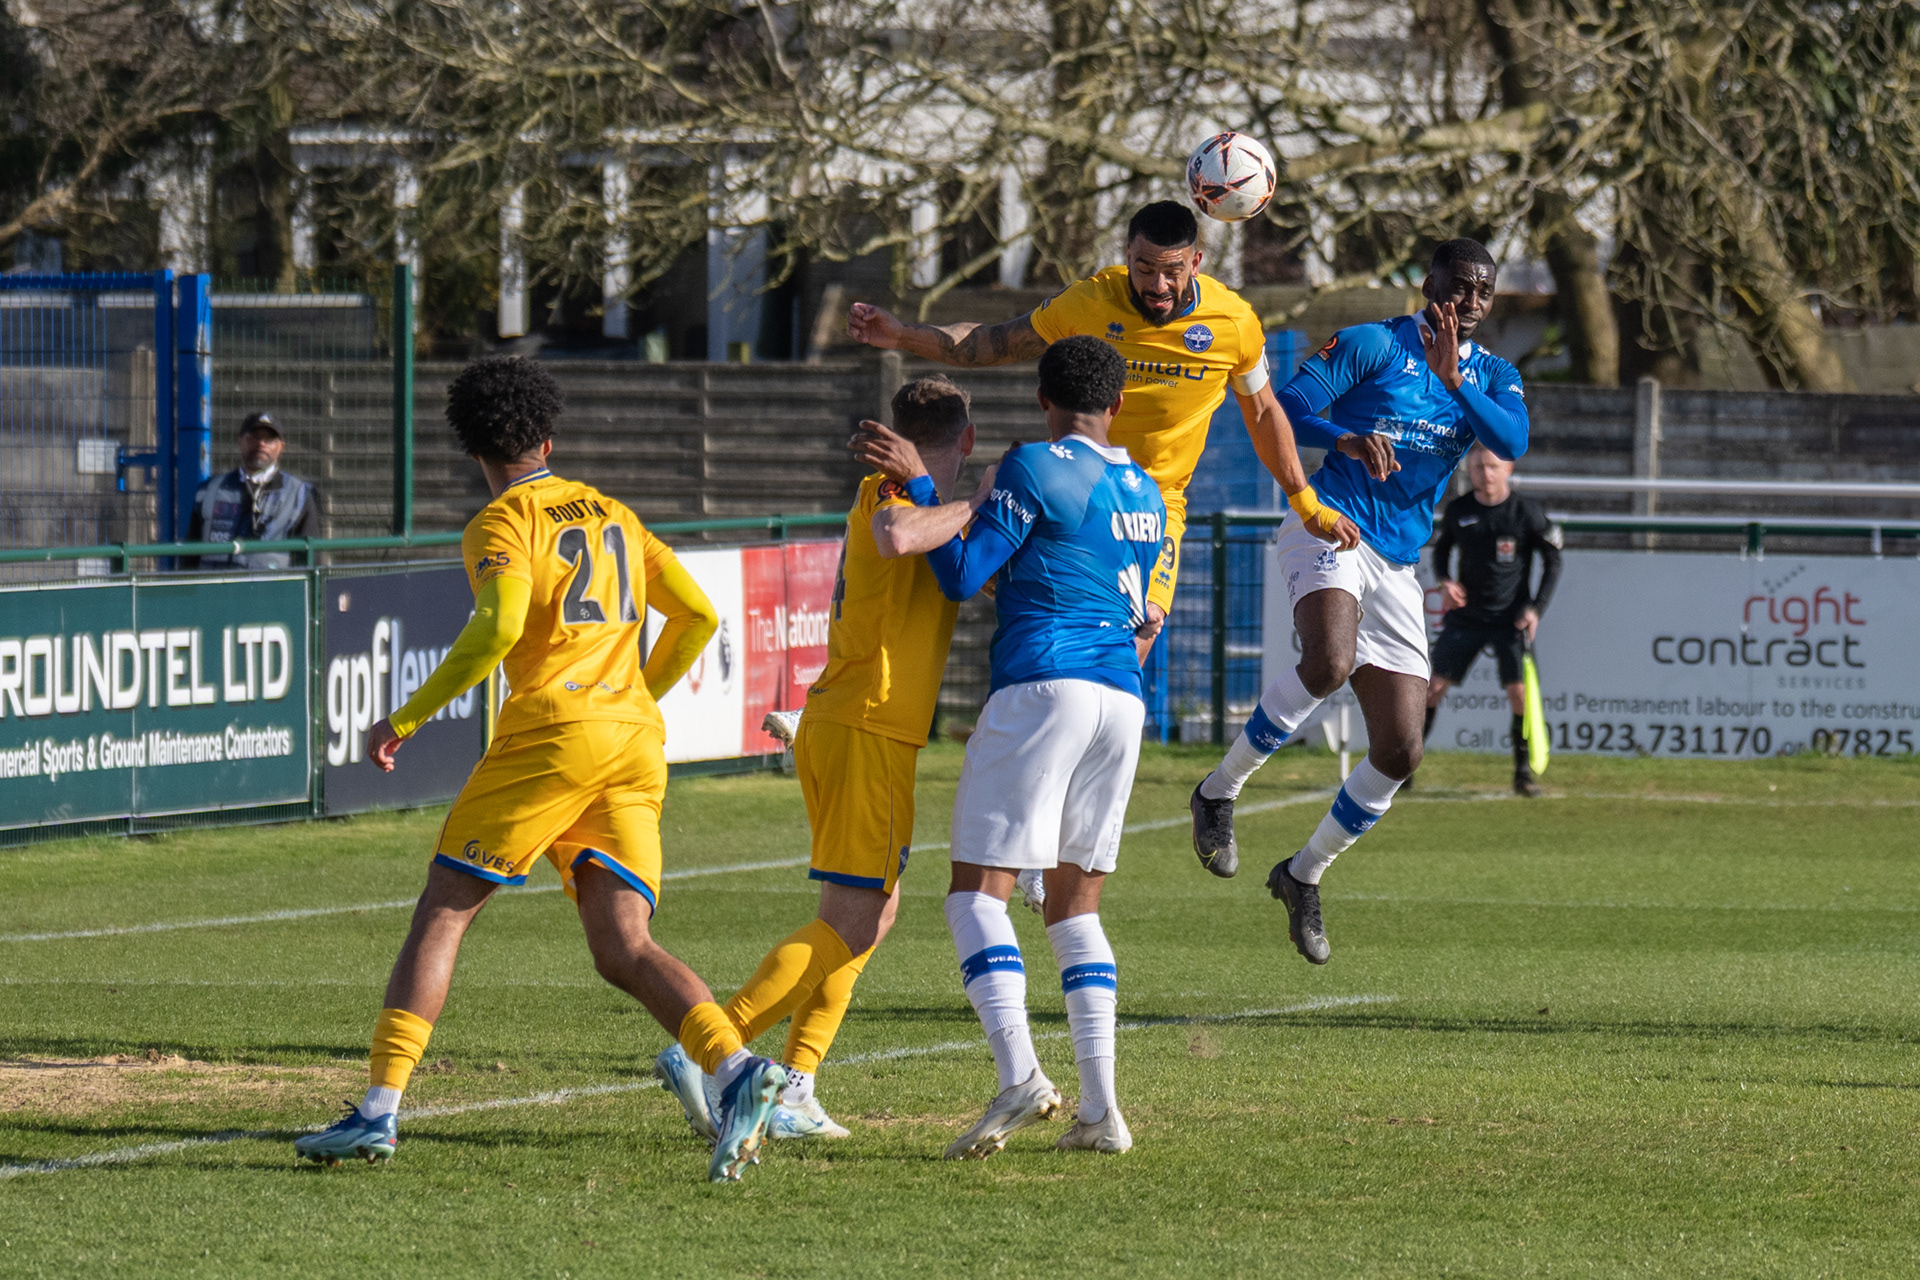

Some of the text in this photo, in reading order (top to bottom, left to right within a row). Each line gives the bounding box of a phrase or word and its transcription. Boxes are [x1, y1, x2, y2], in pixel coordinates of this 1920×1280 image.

[1145, 375, 1179, 388] power
[1417, 419, 1457, 439] Brunel
[1160, 534, 1175, 571] 9
[557, 523, 639, 625] 21
[748, 602, 830, 653] The Nationa
[1743, 585, 1867, 637] right
[1652, 633, 1866, 668] contract
[0, 624, 291, 718] ROUNDTEL LTD
[1777, 676, 1866, 690] SERVICES
[1543, 692, 1567, 712] nd
[1574, 693, 1691, 716] Permanent
[1696, 696, 1765, 718] labour
[1773, 700, 1795, 718] to
[1801, 698, 1836, 718] the
[1842, 702, 1920, 720] constru
[43, 738, 84, 782] Sports
[87, 735, 97, 771] &
[101, 734, 146, 769] Ground
[149, 729, 222, 766] Maintenance
[225, 725, 290, 759] Contractors
[1455, 728, 1494, 748] Call
[1648, 724, 1771, 755] 731170
[1811, 728, 1914, 757] 07825
